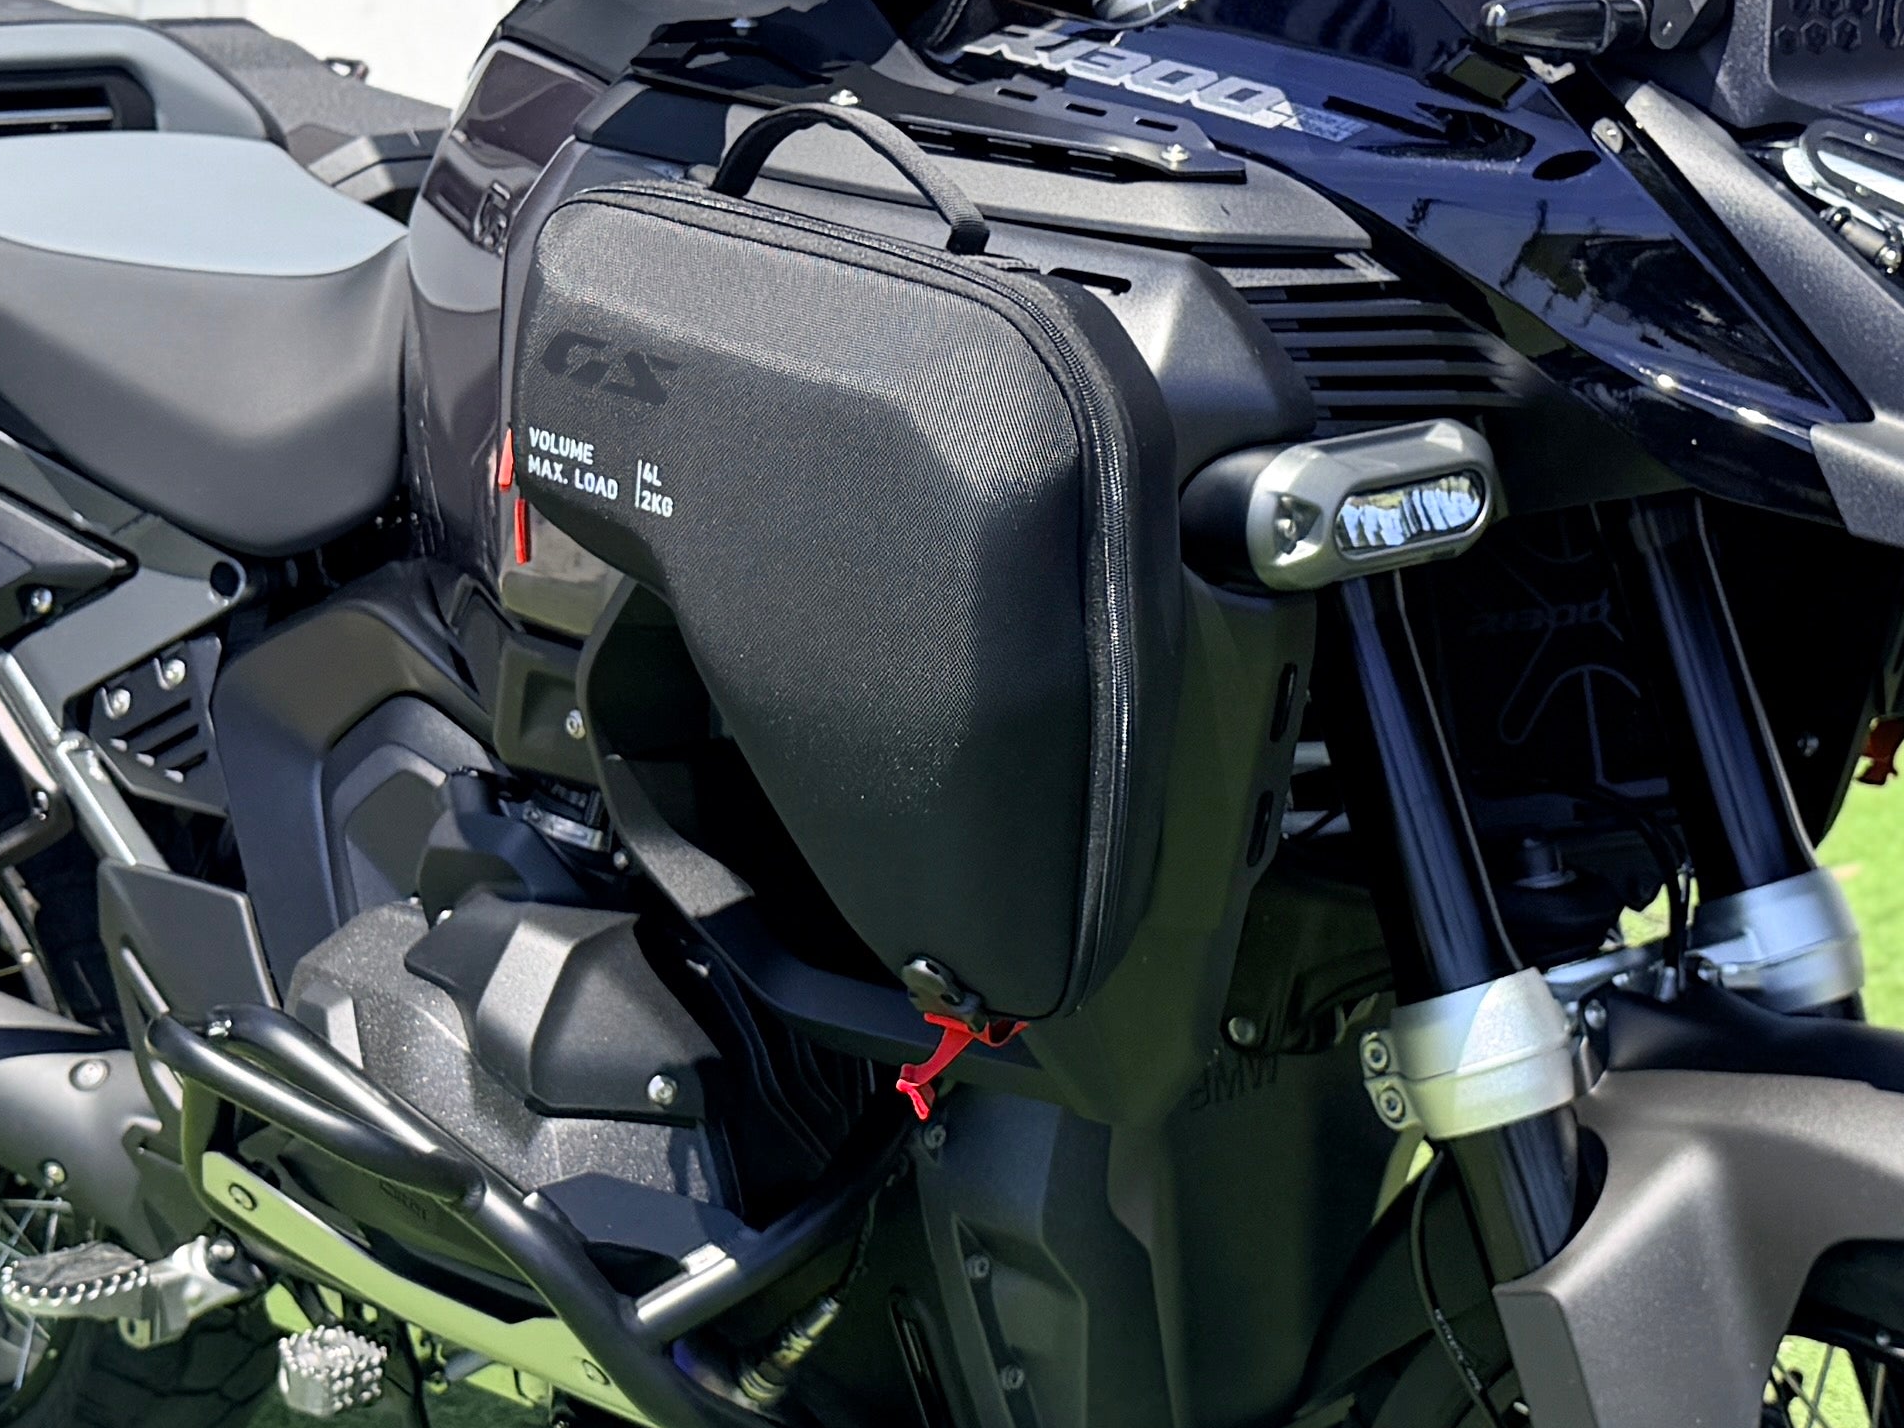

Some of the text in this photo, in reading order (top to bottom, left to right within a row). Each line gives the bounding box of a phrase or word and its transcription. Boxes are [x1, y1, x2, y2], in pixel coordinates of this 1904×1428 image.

[962, 24, 1292, 130] R1300
[543, 329, 681, 406] GS
[528, 426, 595, 466] VOLUME
[527, 453, 619, 500] MAX. LOAD
[640, 489, 674, 518] 2KG
